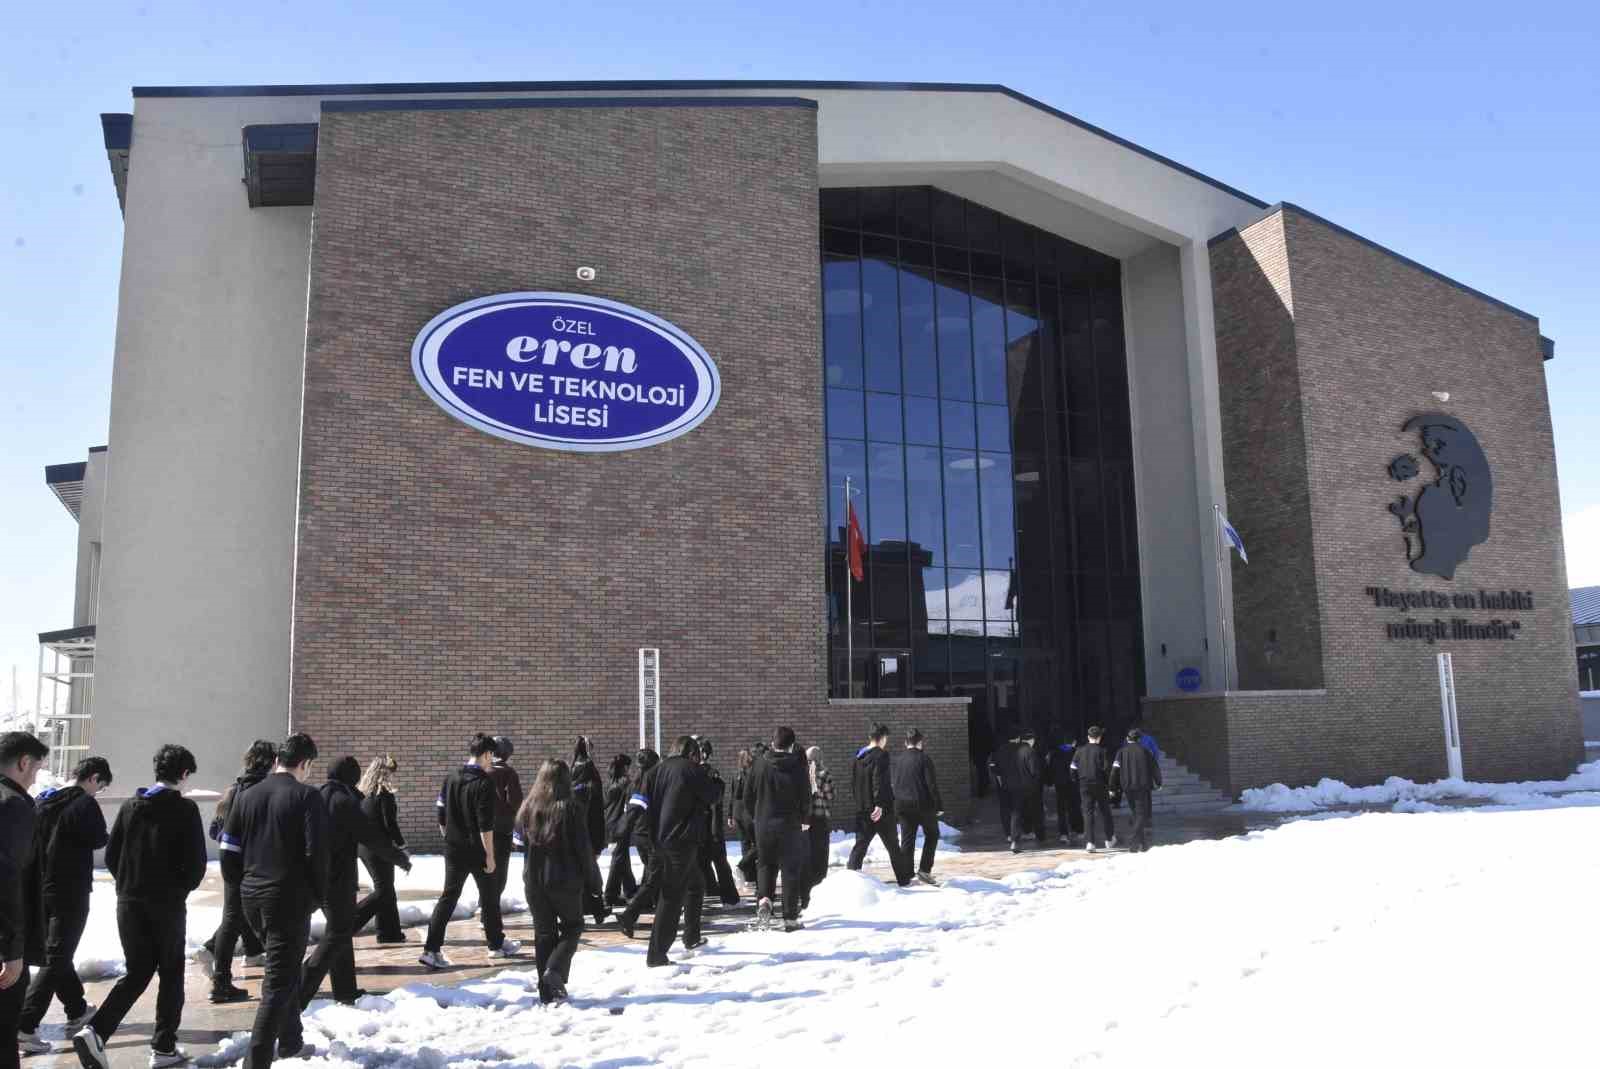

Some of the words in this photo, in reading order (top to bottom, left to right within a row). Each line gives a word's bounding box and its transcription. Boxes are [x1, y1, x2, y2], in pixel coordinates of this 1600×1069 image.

[552, 316, 597, 336] ÖZEL
[506, 335, 638, 374] eren
[453, 366, 503, 389] FEN
[510, 372, 544, 393] VE
[549, 376, 685, 407] TEKNOLOJİ
[534, 399, 609, 428] LİSESİ
